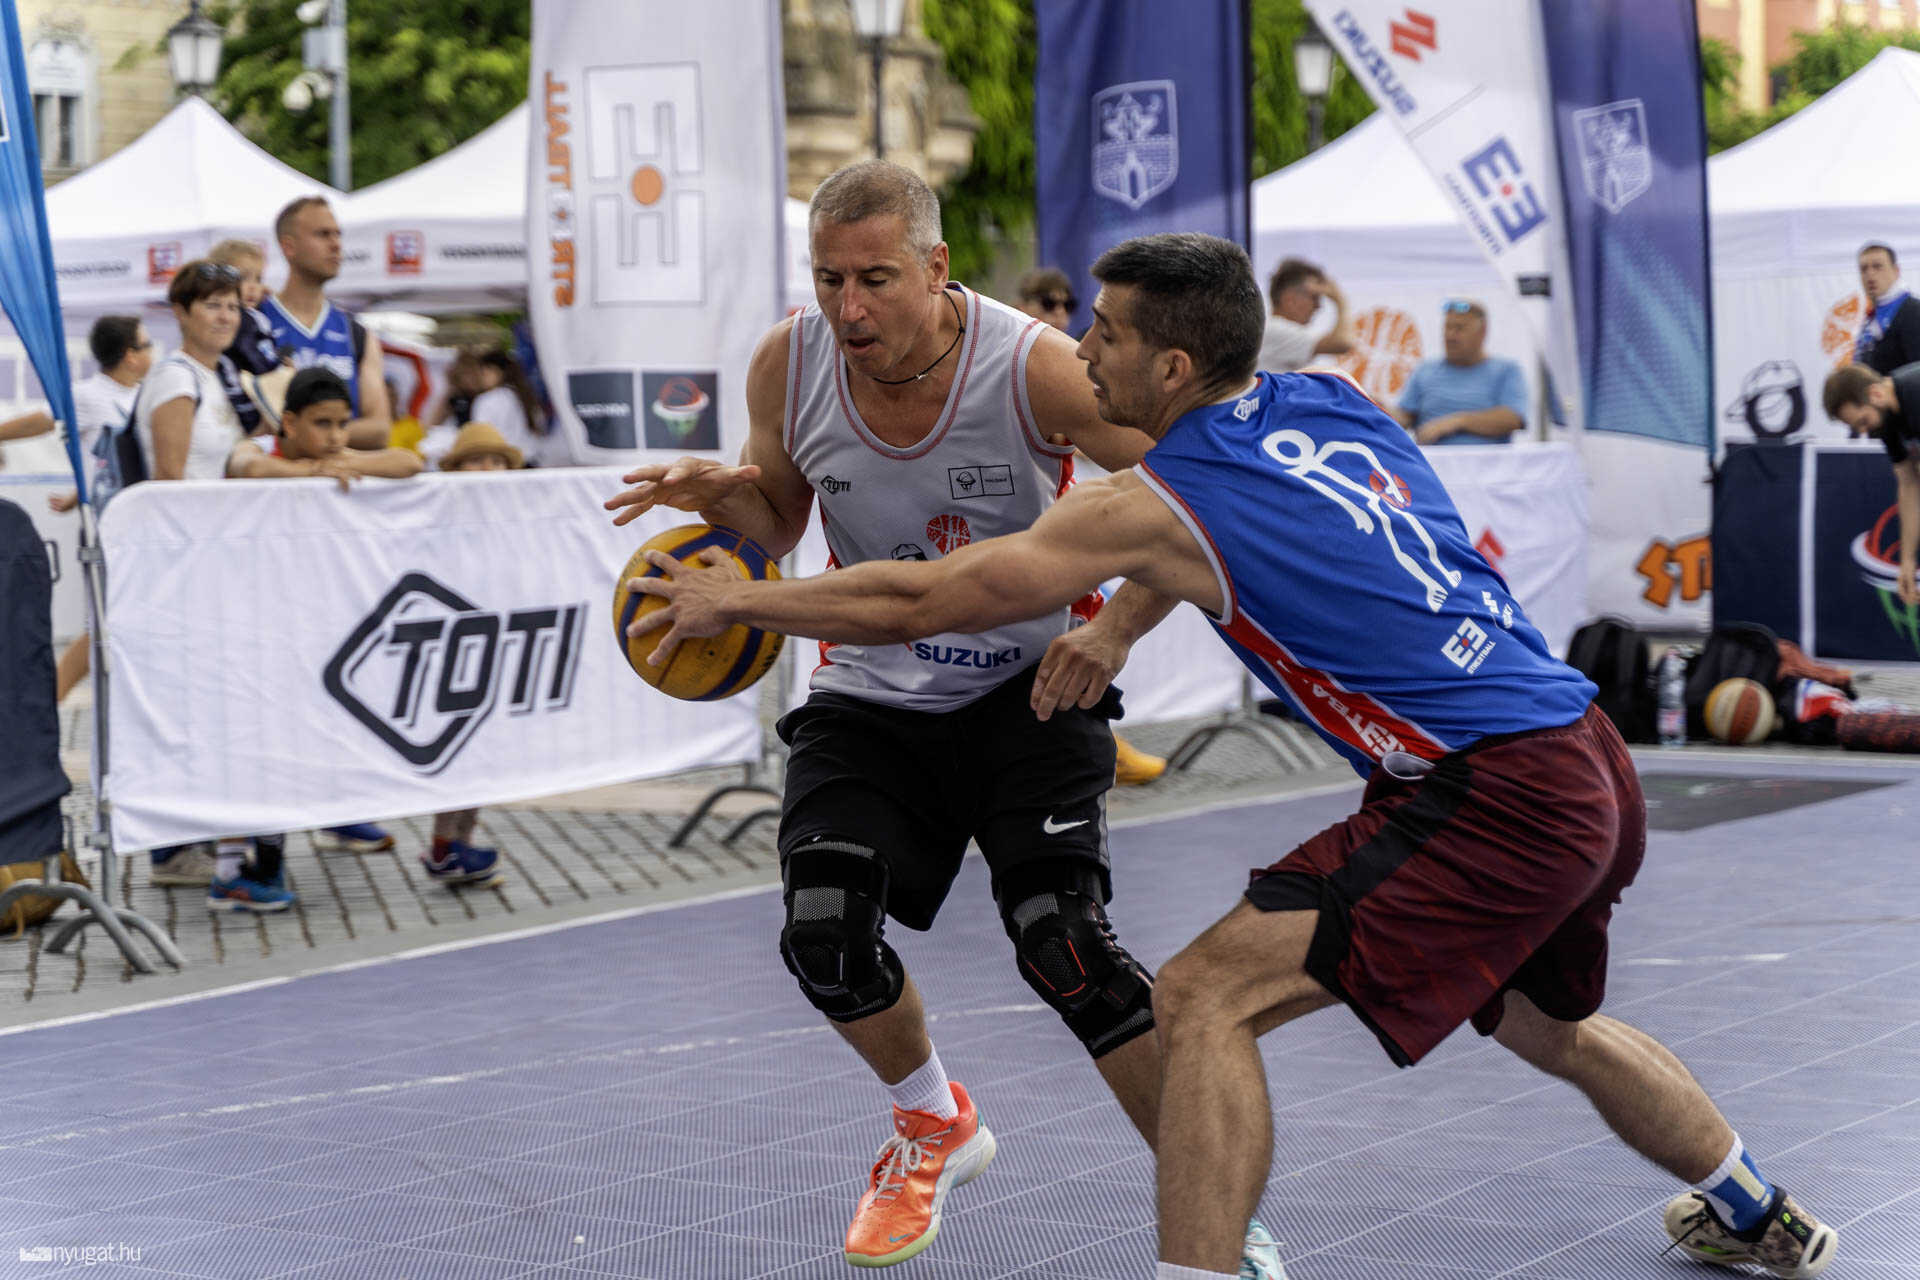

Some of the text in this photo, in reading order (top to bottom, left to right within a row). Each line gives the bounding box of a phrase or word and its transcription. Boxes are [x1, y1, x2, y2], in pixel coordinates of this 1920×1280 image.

[1635, 534, 1712, 607] ST
[387, 602, 587, 726] TOTI
[914, 642, 1022, 669] SUZUKI
